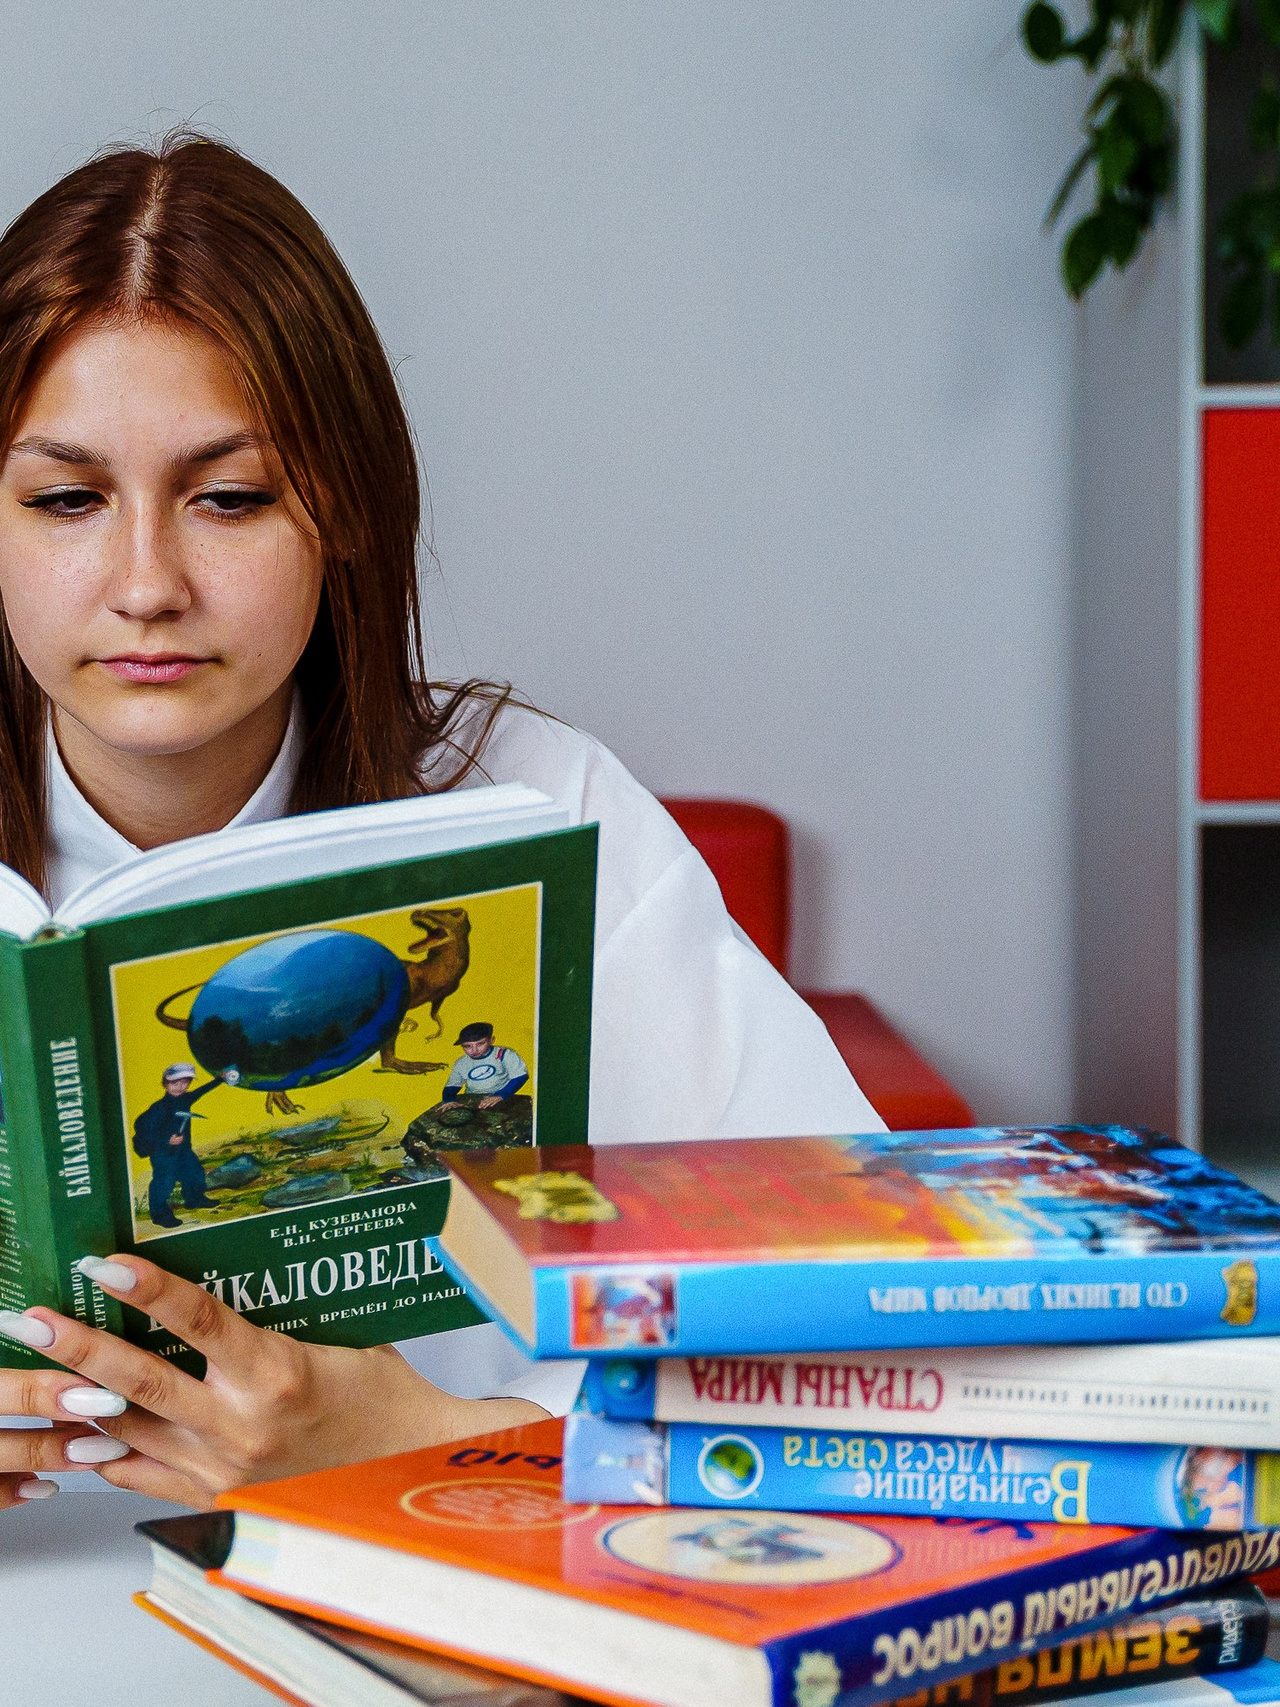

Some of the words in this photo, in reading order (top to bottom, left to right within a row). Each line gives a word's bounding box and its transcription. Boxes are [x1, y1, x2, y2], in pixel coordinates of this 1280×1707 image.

[50, 1037, 92, 1198] БАЙКАЛОВЕДЕНИЕ
[270, 1224, 303, 1239] Е.Н.
[309, 1201, 417, 1231] КУЗЕВАНОВА
[284, 1235, 316, 1248] В.Н.
[322, 1216, 405, 1240] СЕРГЕЕВА
[70, 1259, 87, 1324] ЗЕВАНОВ
[148, 1238, 444, 1332] ЙКАЛОВЕДЕ
[320, 1301, 387, 1324] ВРЕМЁН
[392, 1295, 417, 1310] ДО
[687, 1356, 789, 1405] МИРА
[793, 1362, 944, 1413] СТРАНЫ
[783, 1434, 889, 1467] света
[853, 1459, 1094, 1525] Величайшие
[995, 1614, 1203, 1695] ЗЕМЛЯ
